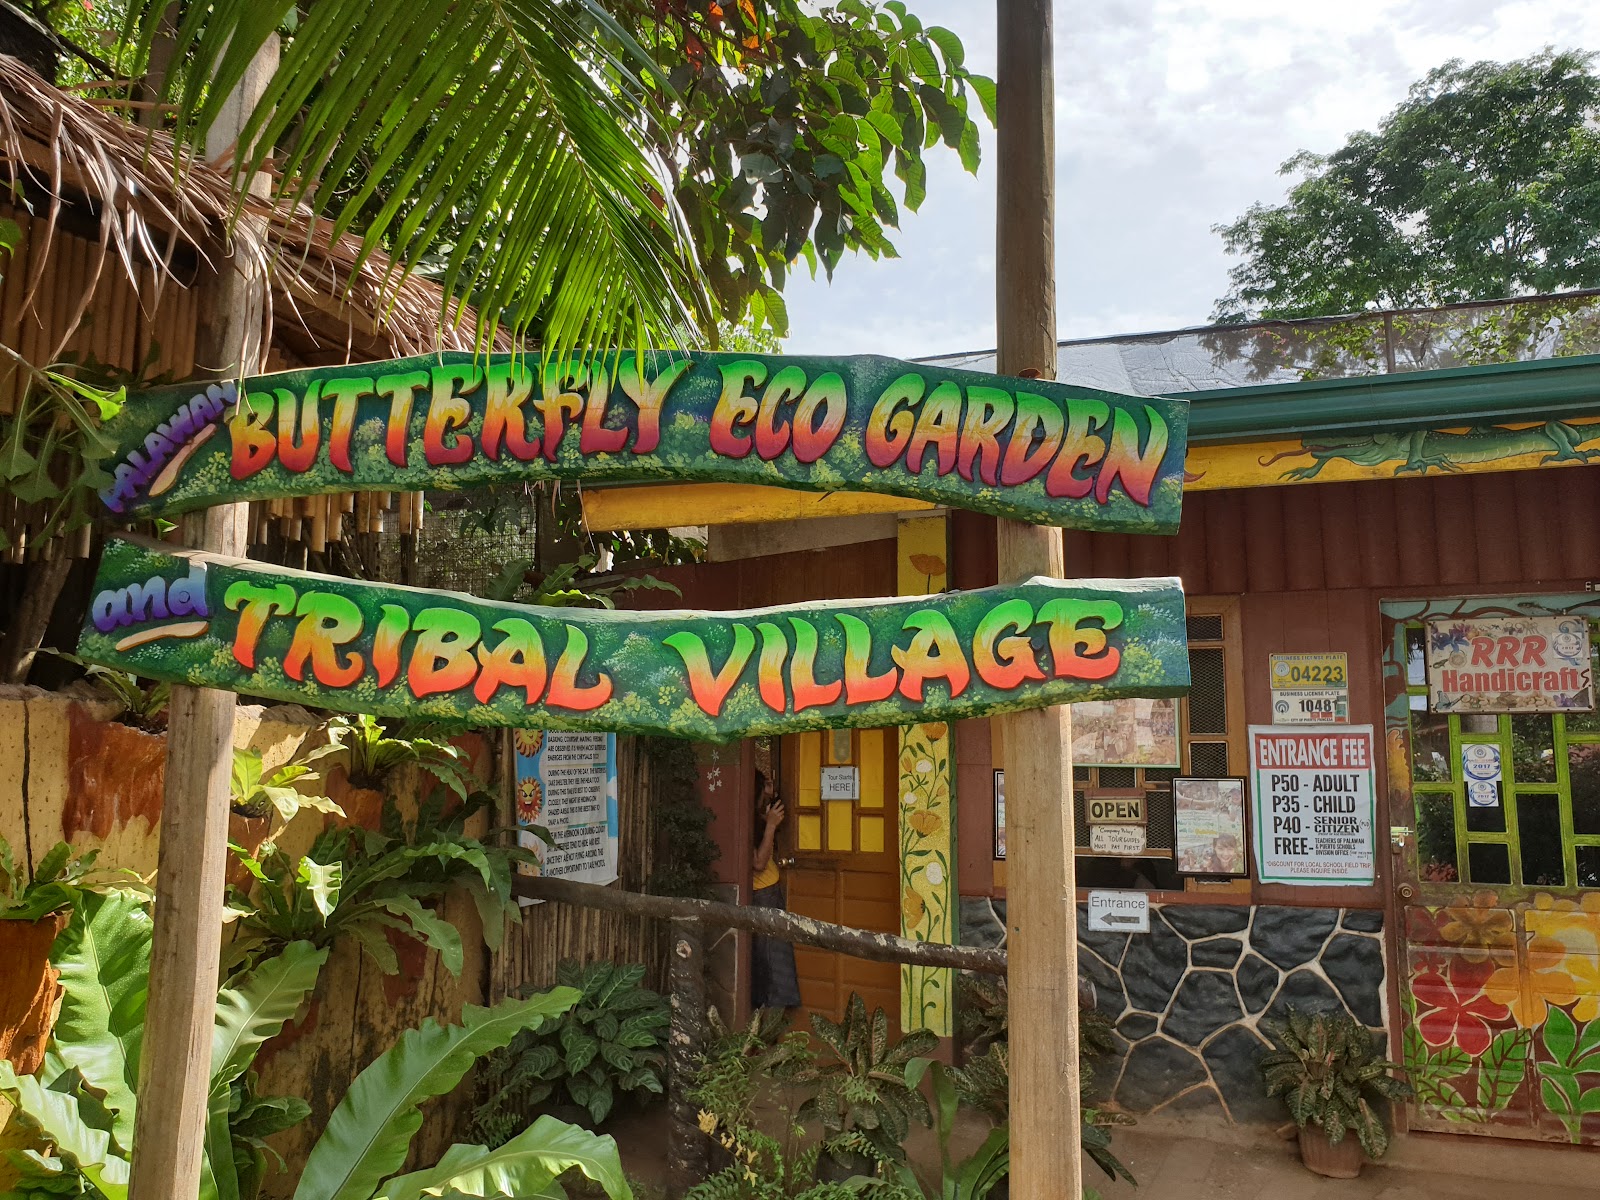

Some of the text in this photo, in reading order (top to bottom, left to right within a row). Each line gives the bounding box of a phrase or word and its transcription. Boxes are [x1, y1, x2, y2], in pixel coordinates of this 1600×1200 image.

[223, 357, 1169, 507] BUTTERFLY ECO GARDEN
[97, 379, 237, 513] PALAWAN
[92, 560, 209, 632] and
[224, 580, 1124, 717] TRIBAL VILLAGE
[1471, 635, 1547, 668] RRR
[1291, 666, 1344, 682] 04223
[1299, 699, 1338, 712] 10481
[1260, 738, 1366, 766] ENTRANCE FEE
[548, 788, 559, 796] DURING
[829, 783, 850, 791] HERE
[1271, 774, 1299, 792] P50
[1313, 774, 1359, 792] ADULT
[1091, 802, 1139, 818] OPEN
[1272, 795, 1300, 813] P35
[1313, 795, 1355, 813] CHILD
[1273, 816, 1301, 834] P40
[1313, 816, 1357, 824] SENIOR
[1314, 824, 1359, 833] CITIZEN
[1091, 896, 1146, 909] Entrance
